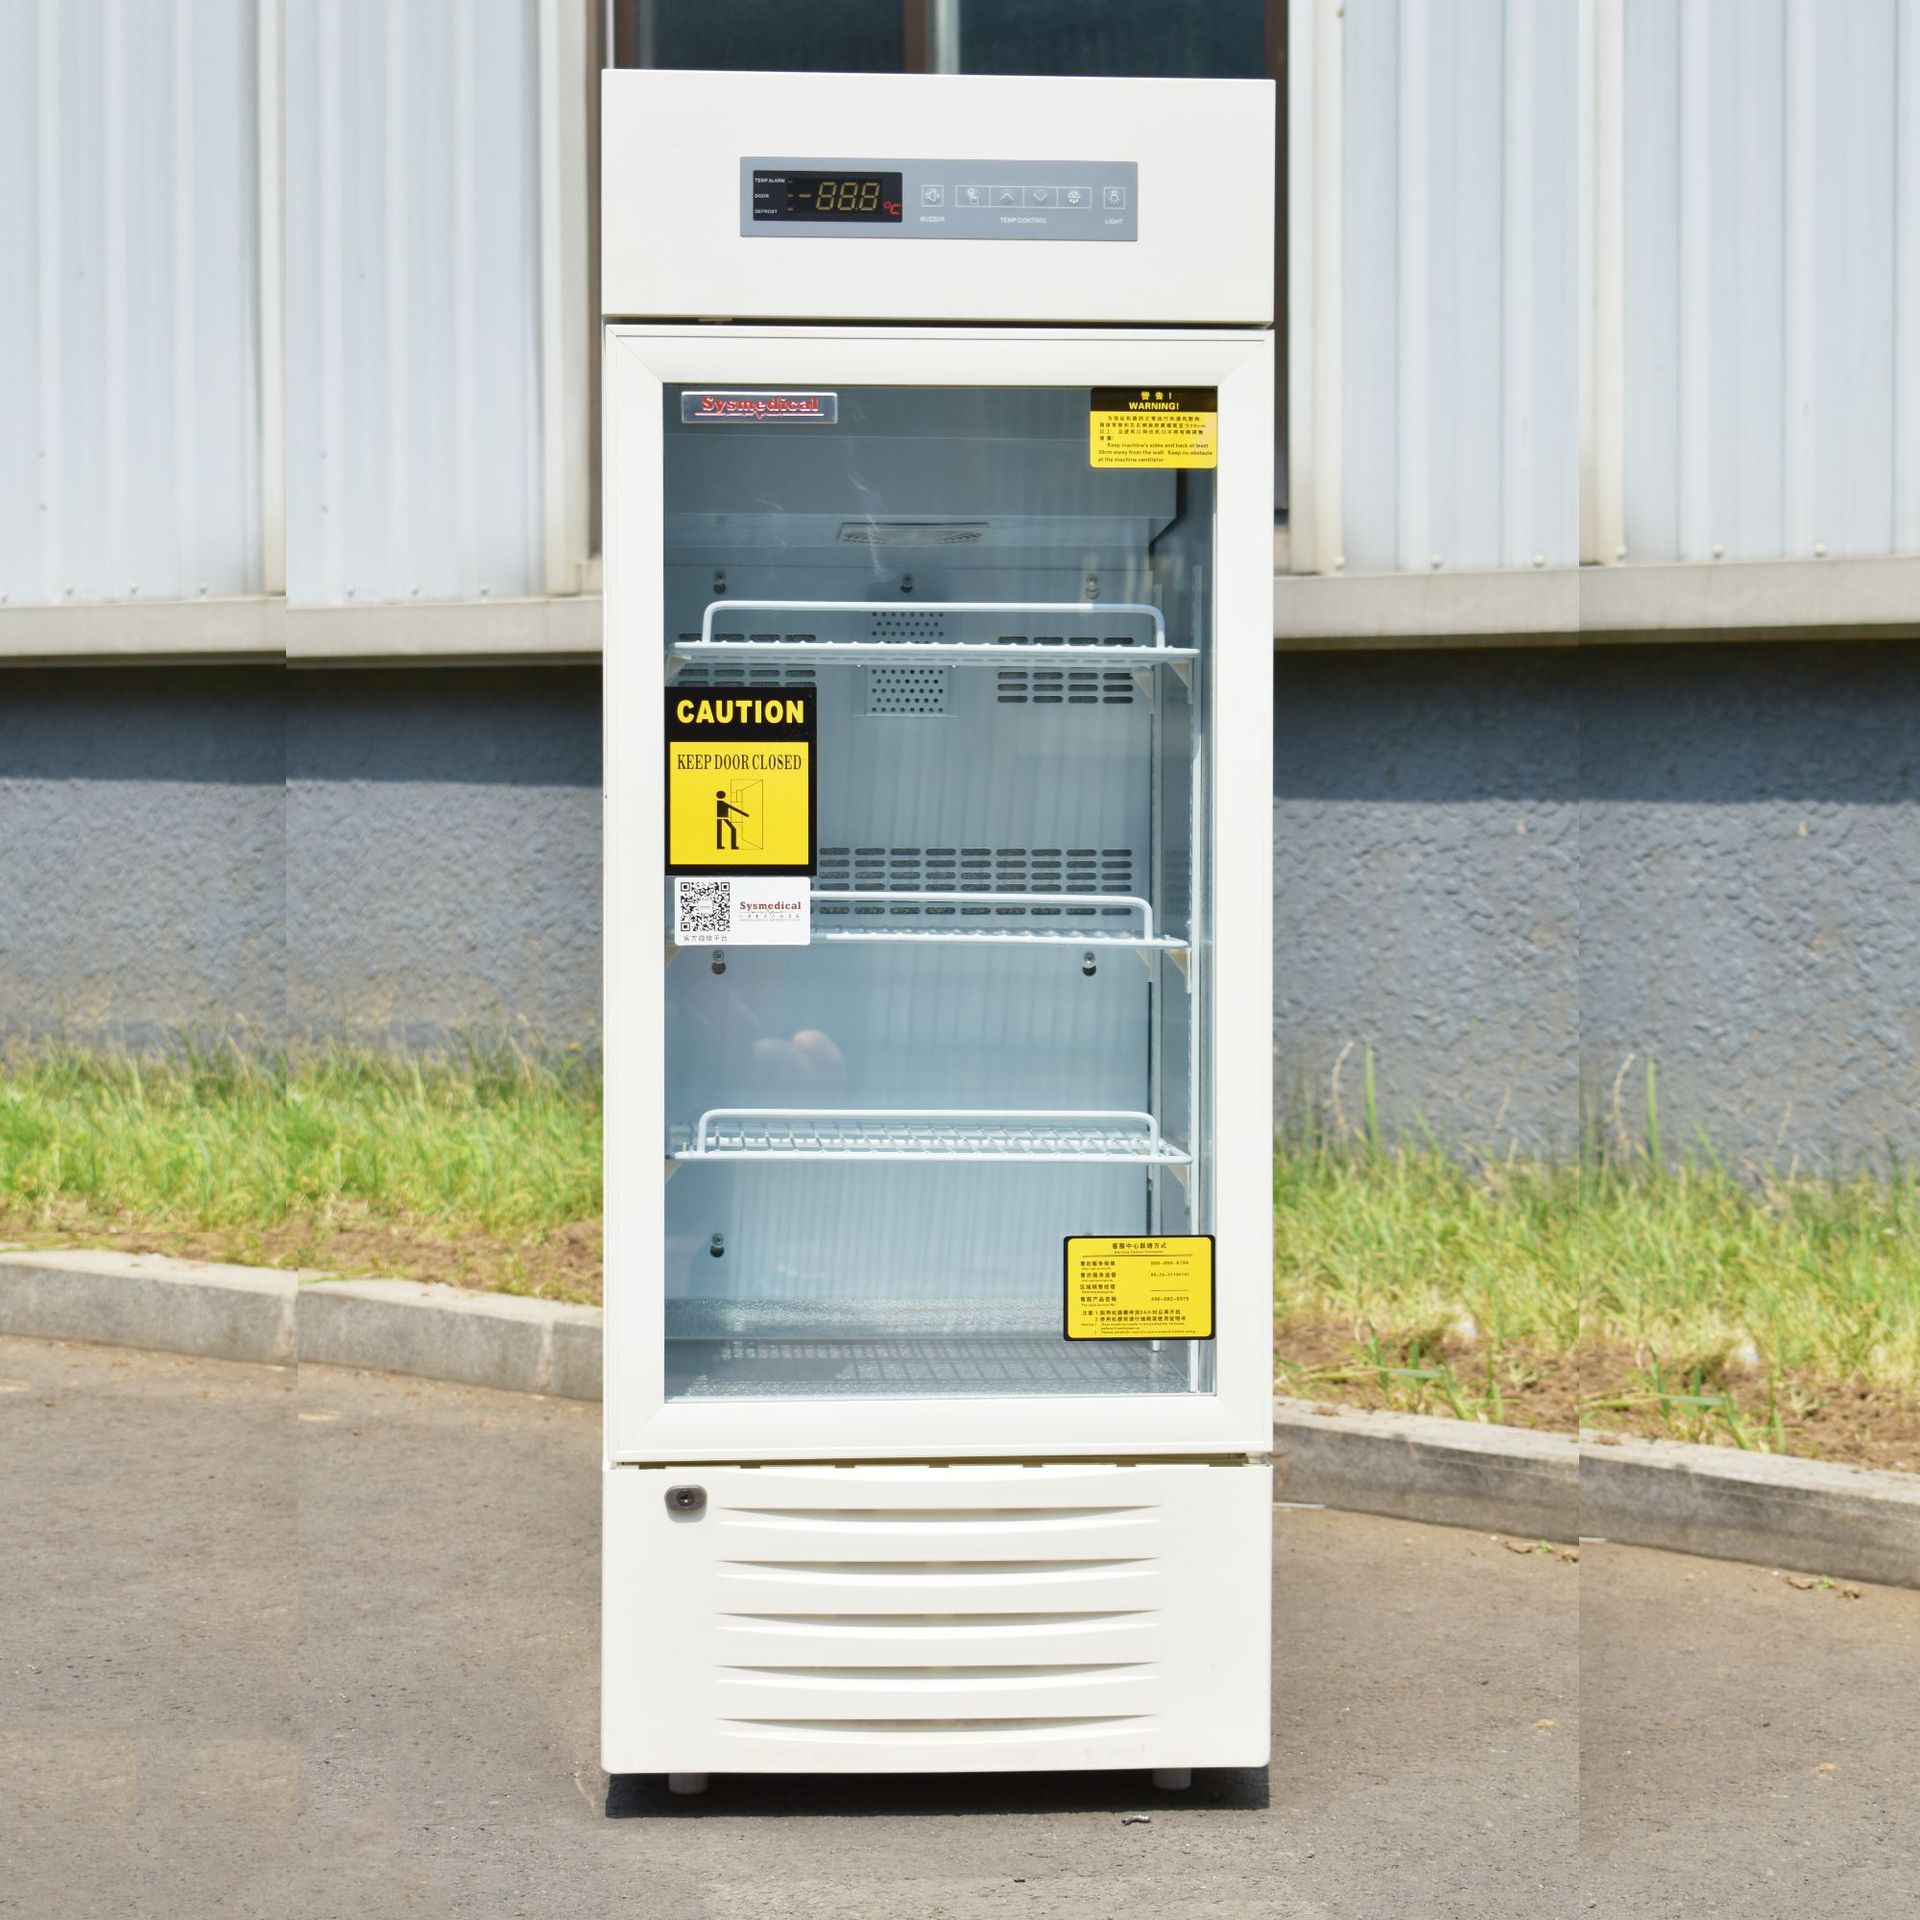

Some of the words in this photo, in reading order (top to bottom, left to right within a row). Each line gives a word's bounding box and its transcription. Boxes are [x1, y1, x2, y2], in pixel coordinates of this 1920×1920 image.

[701, 396, 820, 413] Sysmedical
[1128, 402, 1179, 410] WARNING!
[677, 700, 804, 724] CAUTION
[677, 753, 712, 770] KEEP
[714, 753, 750, 770] DOOR
[752, 753, 802, 770] CLOSED
[740, 901, 802, 911] Sysmedical
